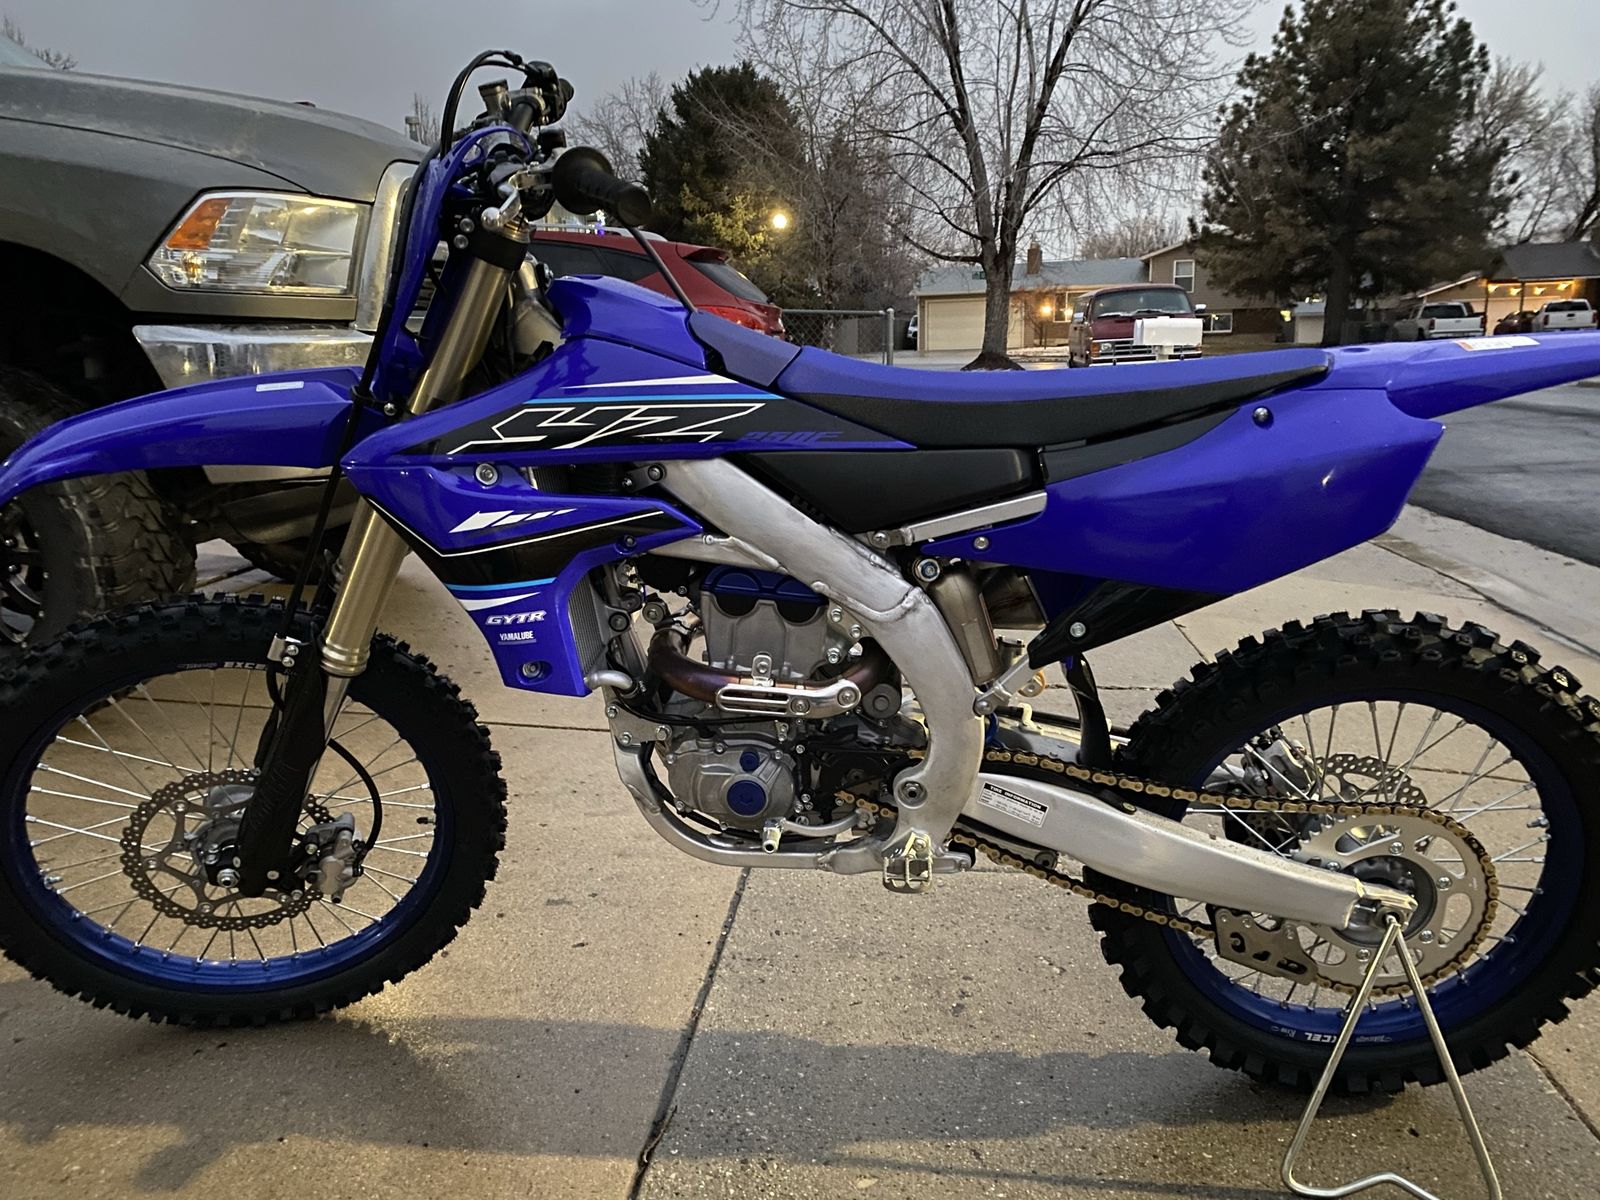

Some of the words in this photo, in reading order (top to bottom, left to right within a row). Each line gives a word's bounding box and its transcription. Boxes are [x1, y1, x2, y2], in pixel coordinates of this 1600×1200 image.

[485, 610, 547, 625] GYTR
[499, 630, 534, 641] YAMALUBE
[223, 661, 267, 670] EXCE
[990, 785, 1003, 794] TIRE
[1004, 791, 1042, 809] INFORMATION
